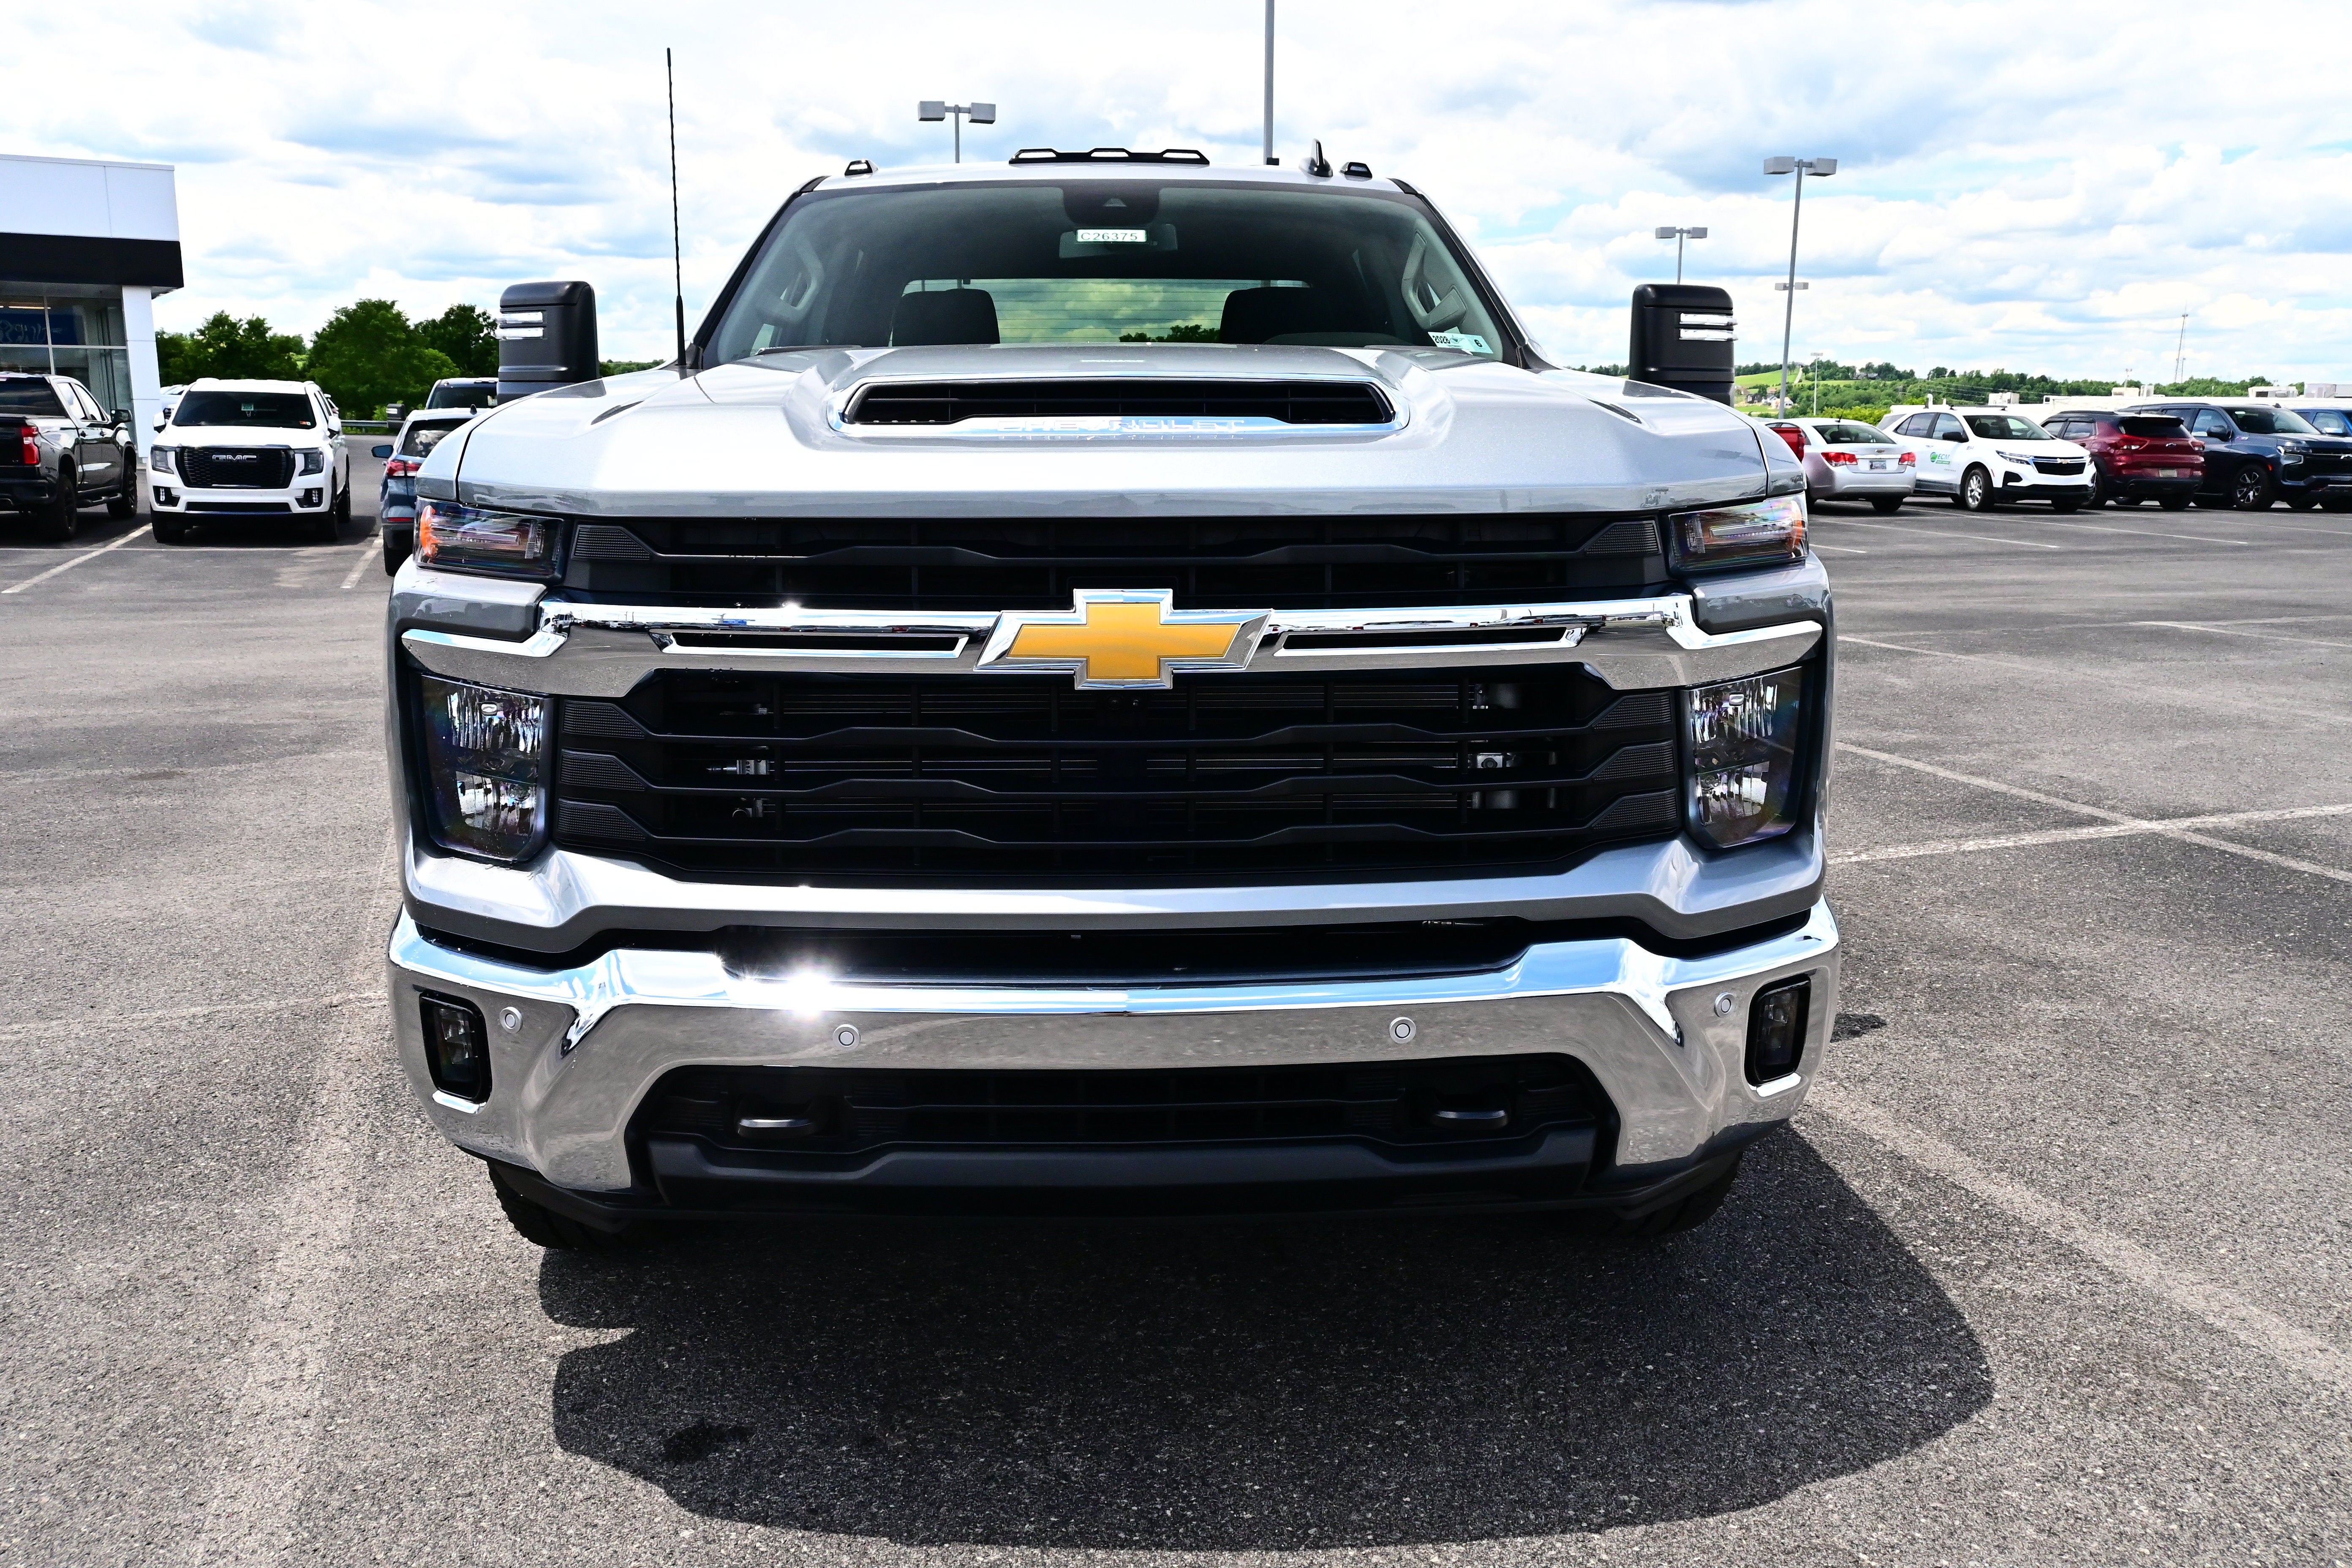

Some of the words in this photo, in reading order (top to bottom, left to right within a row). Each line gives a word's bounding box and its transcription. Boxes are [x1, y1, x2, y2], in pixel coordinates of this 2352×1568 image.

[1081, 232, 1138, 241] C26375
[1432, 335, 1451, 344] 2028
[1474, 339, 1483, 348] 6
[212, 455, 257, 463] GMC
